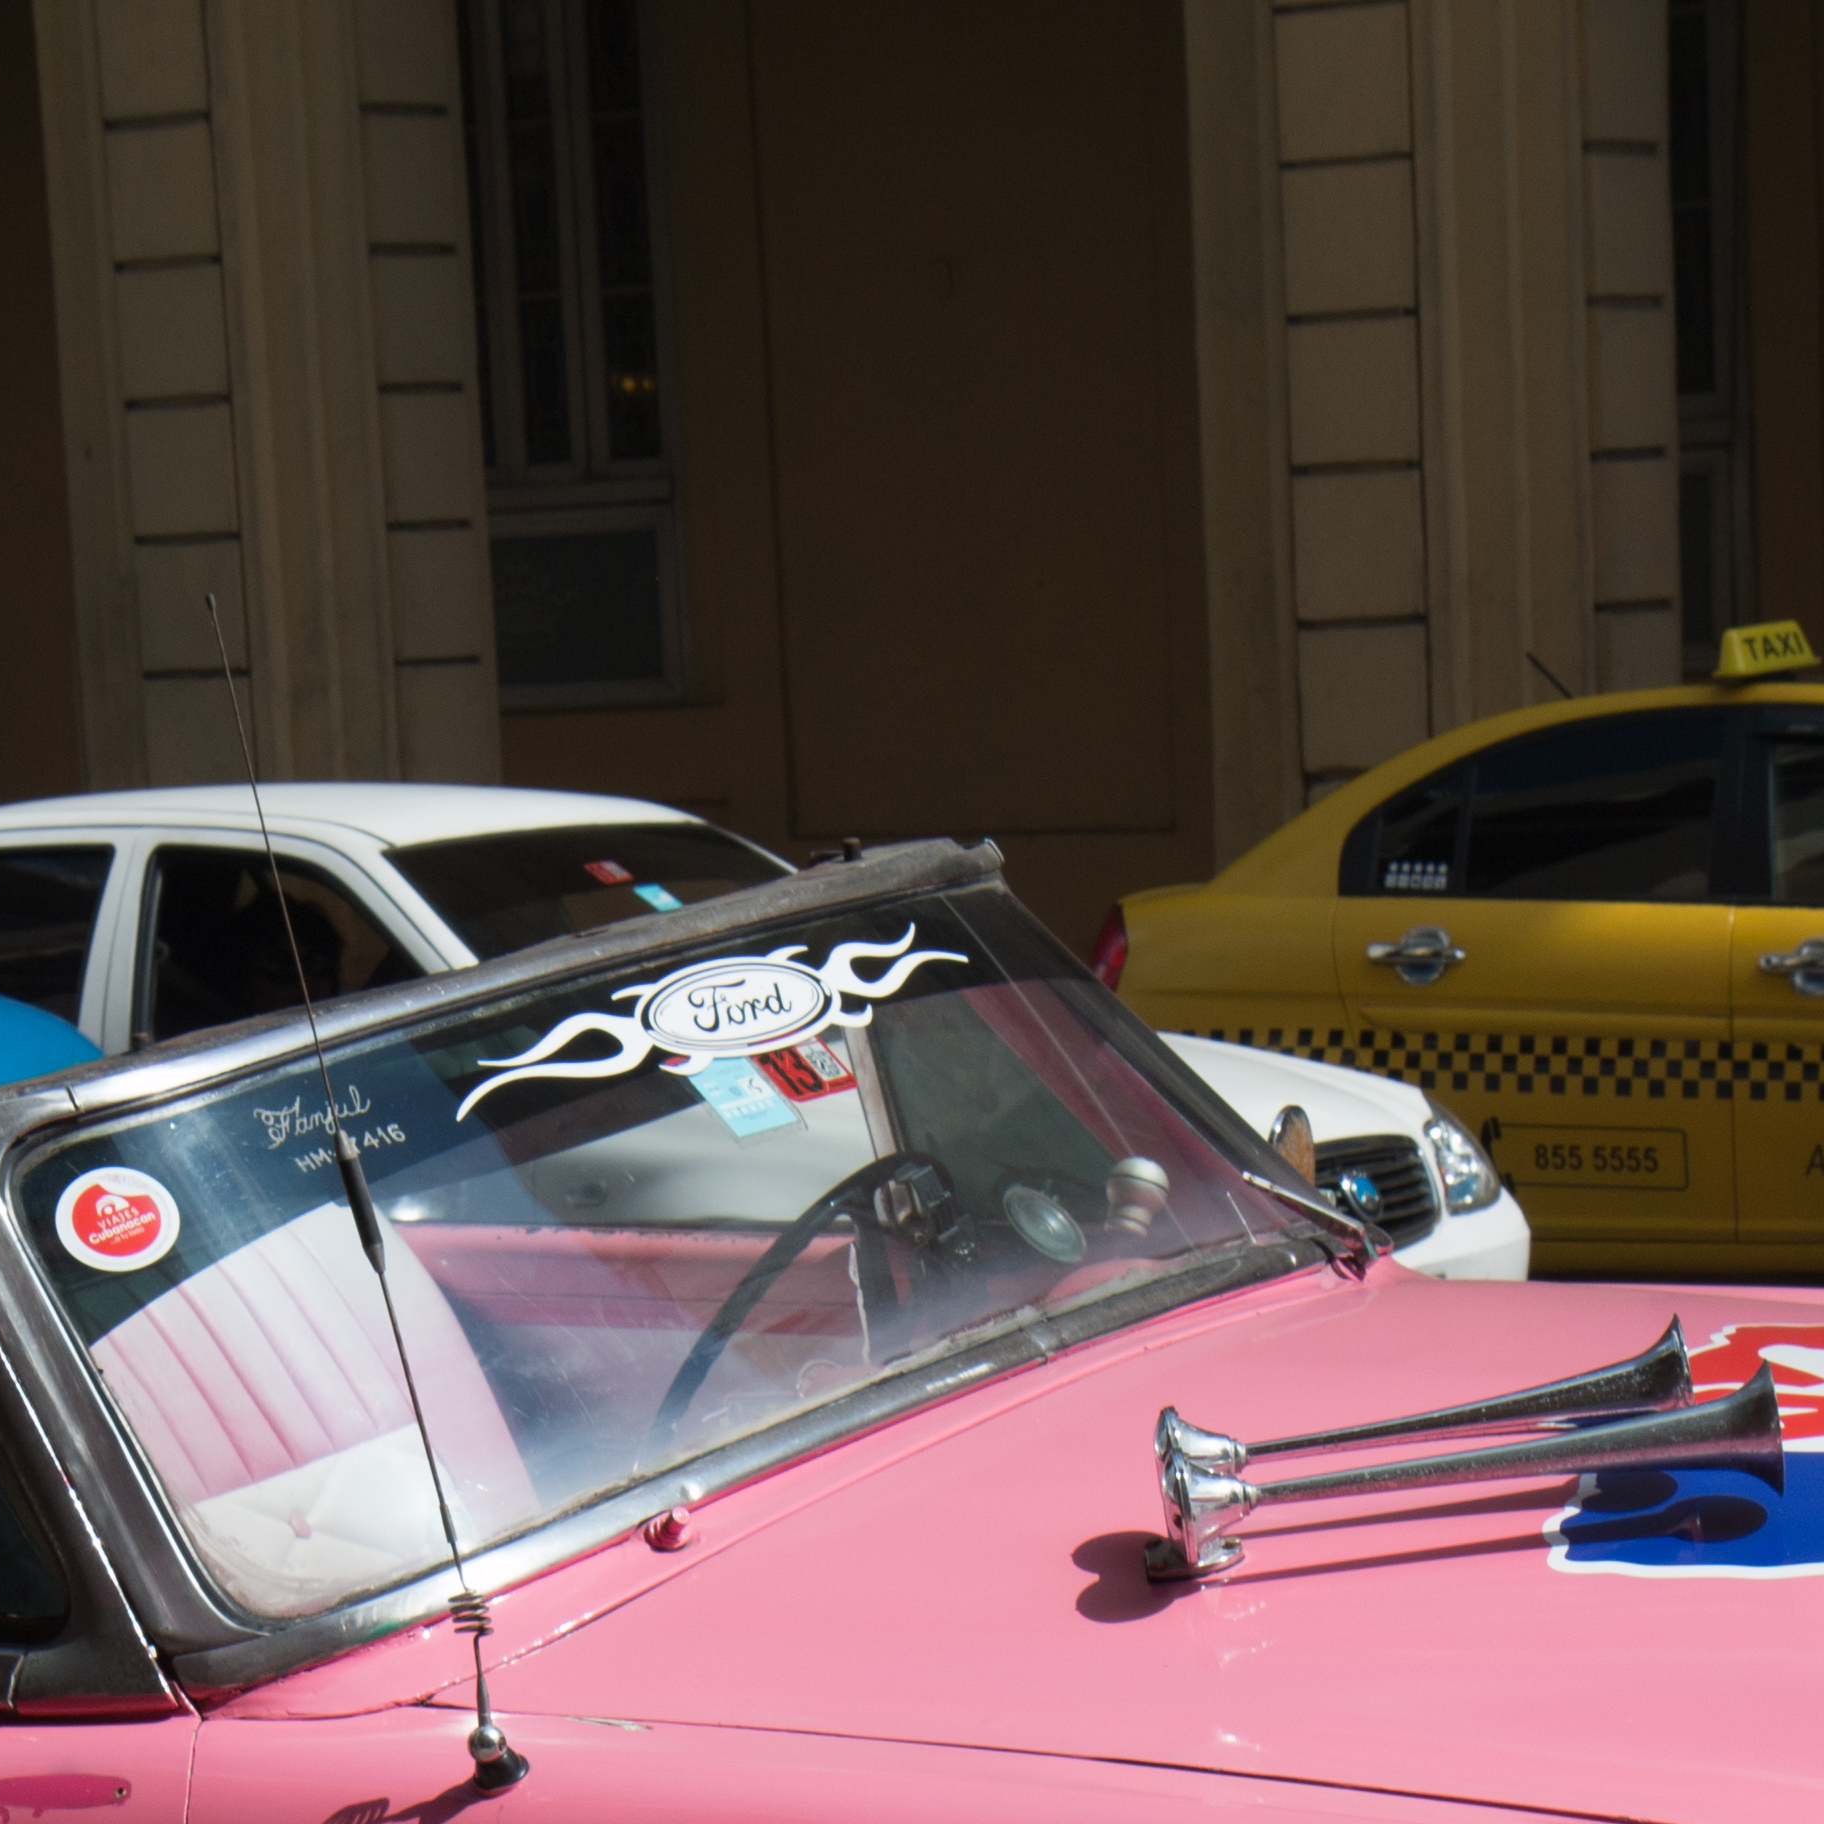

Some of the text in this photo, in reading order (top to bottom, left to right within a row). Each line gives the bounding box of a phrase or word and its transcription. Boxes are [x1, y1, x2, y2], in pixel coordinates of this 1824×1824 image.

[1743, 631, 1805, 662] TAXI
[687, 978, 793, 1033] Ford
[1533, 1143, 1659, 1174] 855 5555
[88, 1211, 156, 1244] Cubanacan
[97, 1207, 139, 1228] VIAJES
